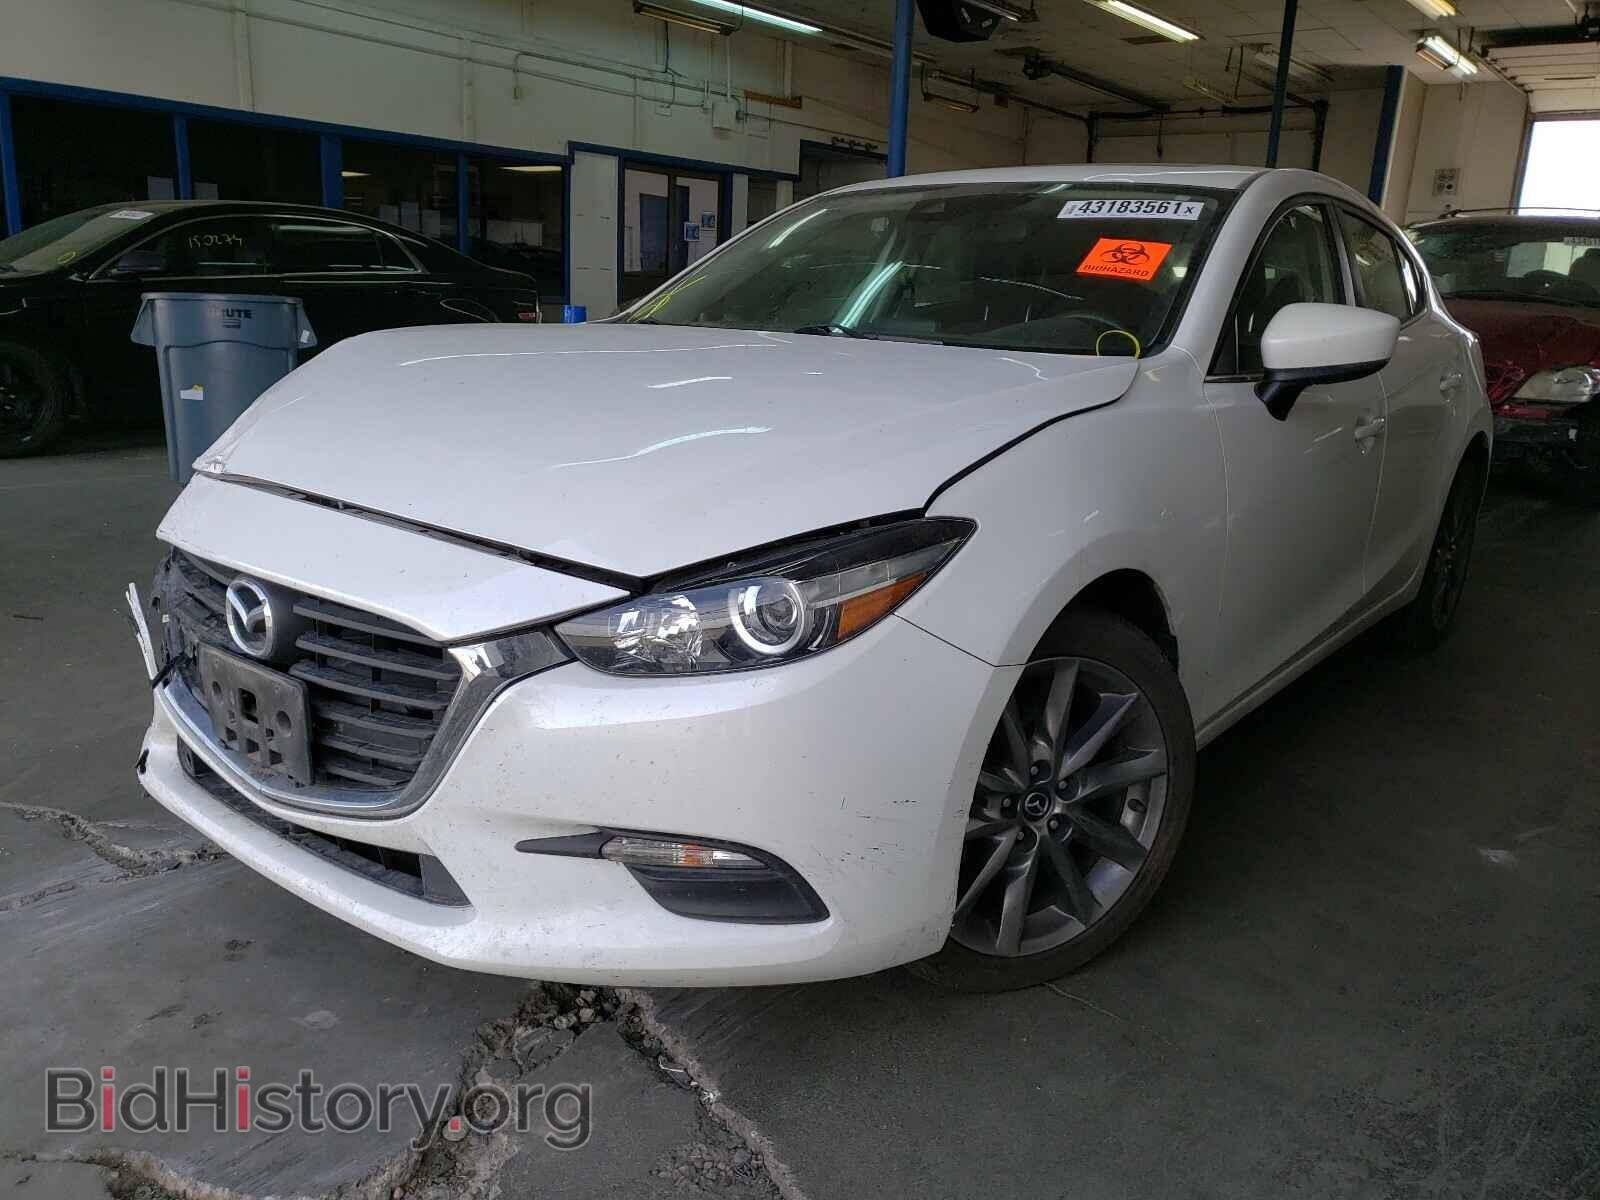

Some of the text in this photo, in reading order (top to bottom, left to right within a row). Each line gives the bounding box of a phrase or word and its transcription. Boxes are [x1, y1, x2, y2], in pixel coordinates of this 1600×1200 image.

[1078, 200, 1182, 215] 43183561
[1083, 264, 1149, 276] BIOHAZARD
[217, 308, 253, 319] UTE
